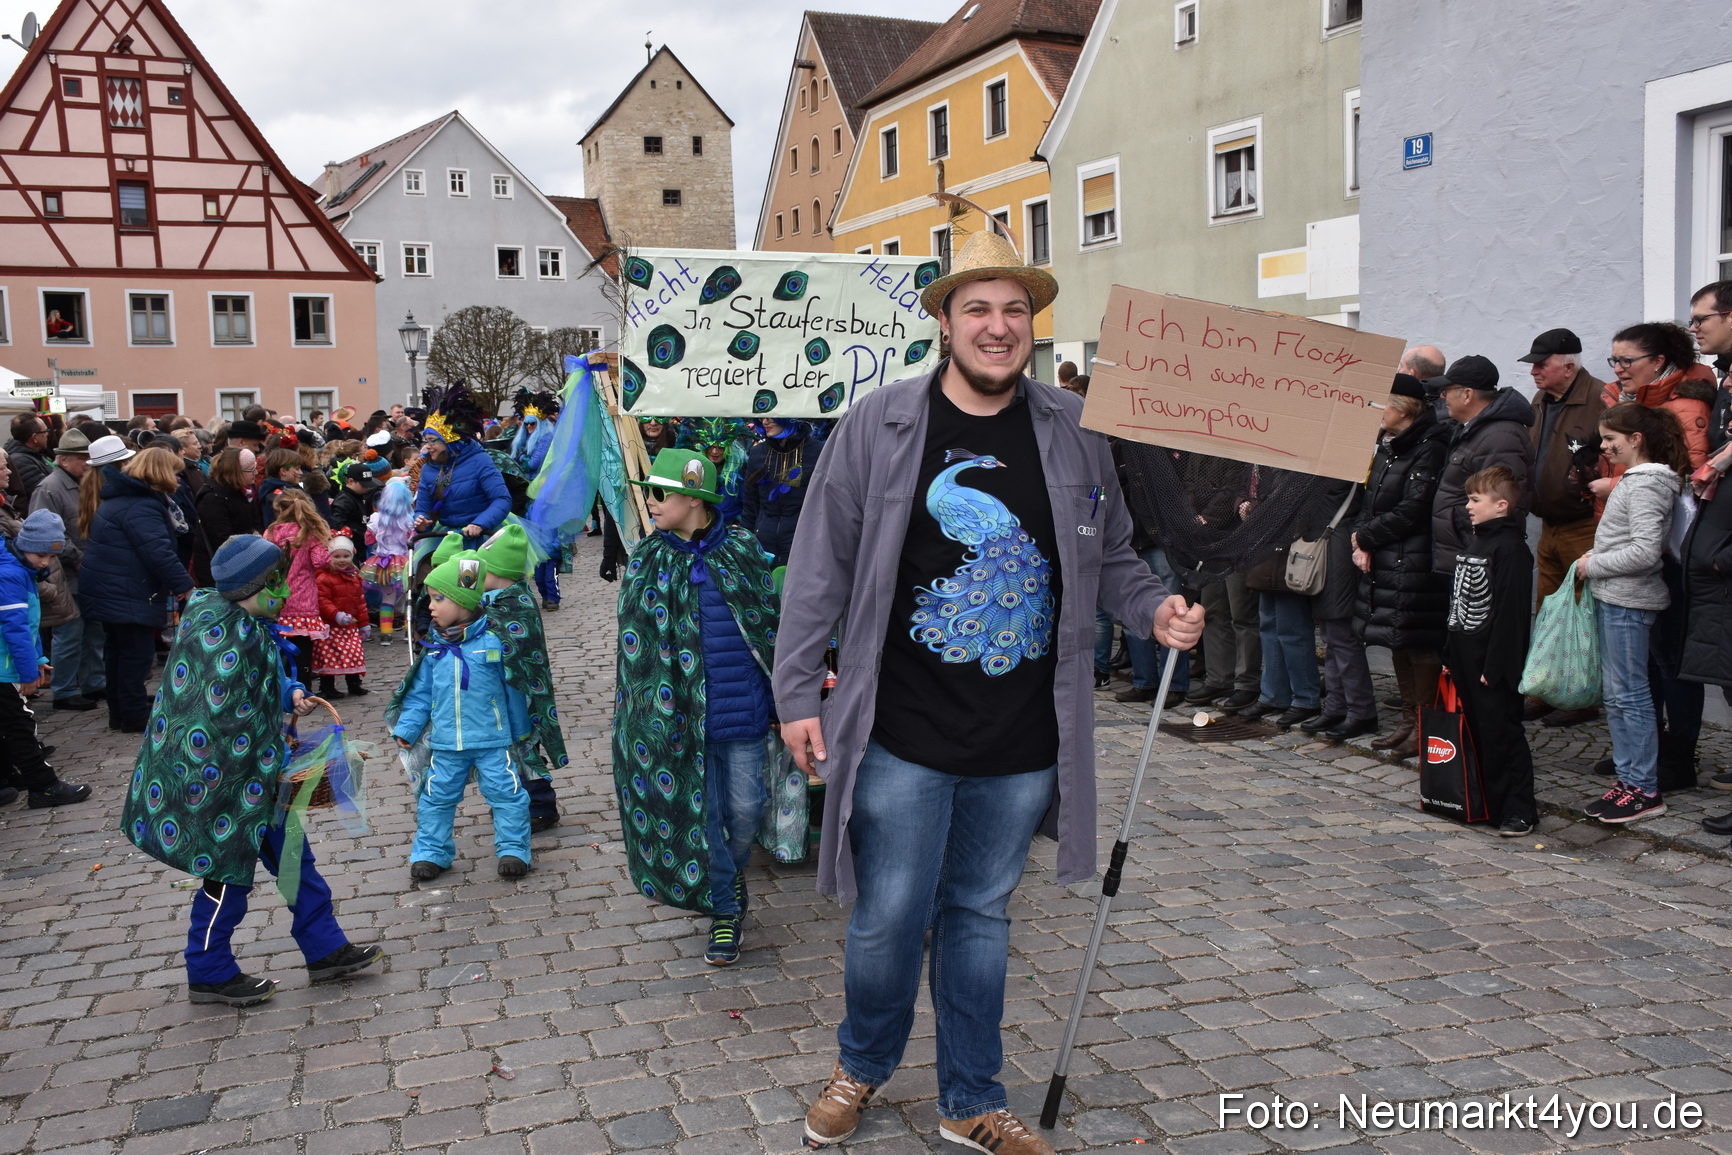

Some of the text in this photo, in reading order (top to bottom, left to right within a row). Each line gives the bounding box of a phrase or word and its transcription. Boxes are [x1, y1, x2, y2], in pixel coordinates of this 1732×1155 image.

[1411, 138, 1424, 155] 19
[626, 258, 700, 329] Hecht
[722, 294, 906, 339] Staufersbuch
[1125, 300, 1362, 374] Ich bin Flocky
[680, 352, 768, 398] regiert
[782, 353, 830, 389] der
[1210, 366, 1265, 390] suche
[1274, 377, 1366, 408] meinen
[1119, 386, 1269, 435] Traumpfau
